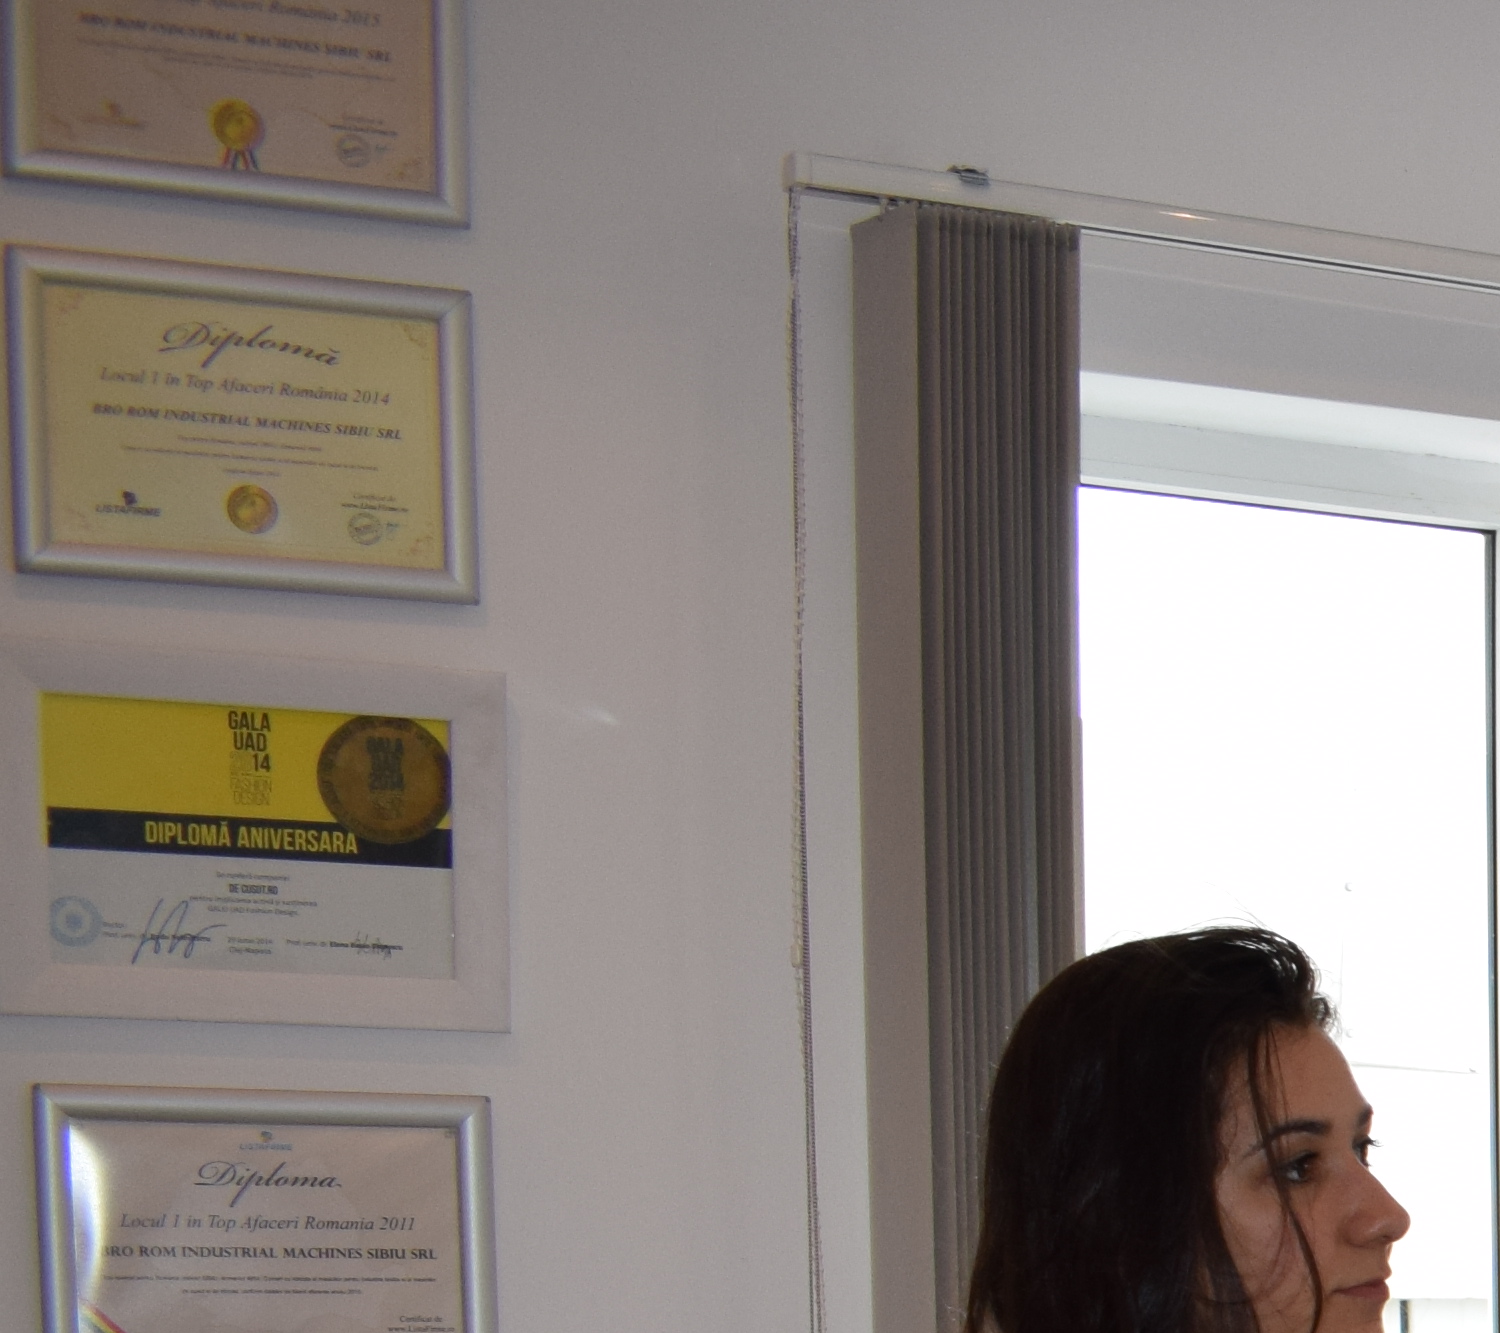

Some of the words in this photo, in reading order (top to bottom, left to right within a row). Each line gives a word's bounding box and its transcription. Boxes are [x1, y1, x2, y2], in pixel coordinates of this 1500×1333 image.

[100, 366, 146, 385] Locul
[185, 373, 213, 393] Top
[217, 377, 275, 398] Afaceri
[352, 389, 391, 406] 2014
[126, 406, 161, 420] ROM
[163, 409, 251, 428] INDUSTRIAL
[255, 417, 332, 434] MACHINES
[334, 424, 374, 439] SIBIU
[376, 427, 402, 440] SRL
[228, 710, 271, 732] GALA
[233, 731, 267, 752] UAD
[145, 819, 231, 847] DIPLOMĂ
[237, 829, 358, 855] ANIVERSARA
[195, 1161, 342, 1208] Diploma
[121, 1213, 168, 1229] Locul
[172, 1214, 180, 1229] 1
[187, 1214, 202, 1229] in
[208, 1214, 237, 1233] Top
[240, 1214, 300, 1231] Afaceri
[304, 1216, 375, 1231] Romania
[379, 1216, 416, 1231] 2011
[139, 1246, 177, 1260] ROM
[182, 1246, 279, 1260] INDUSTRIAL
[283, 1246, 363, 1260] MACHINES
[366, 1247, 408, 1261] SIBIU
[411, 1247, 438, 1261] SRL
